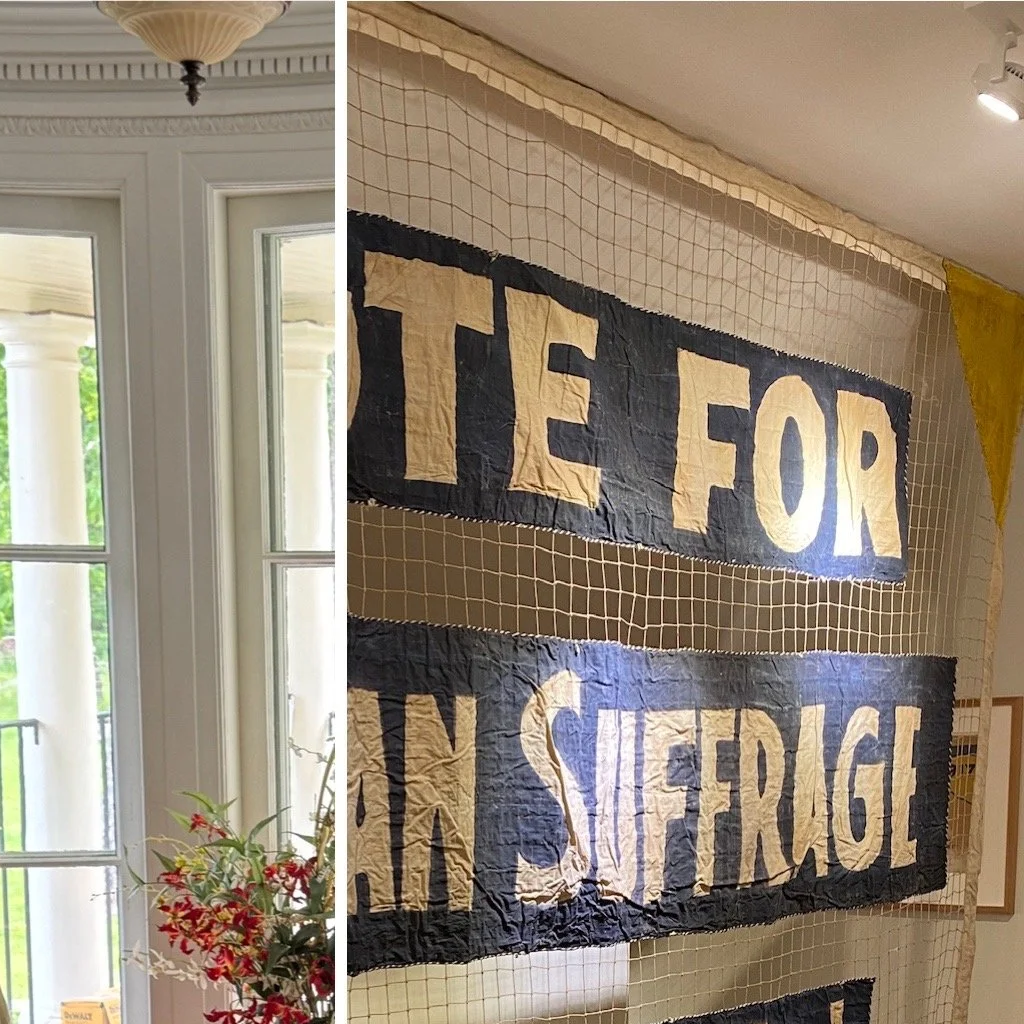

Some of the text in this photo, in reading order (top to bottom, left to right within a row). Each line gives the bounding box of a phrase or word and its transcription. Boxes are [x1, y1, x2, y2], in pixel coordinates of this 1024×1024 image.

[347, 250, 903, 558] TE FOR
[514, 669, 922, 906] SUFFRAGE
